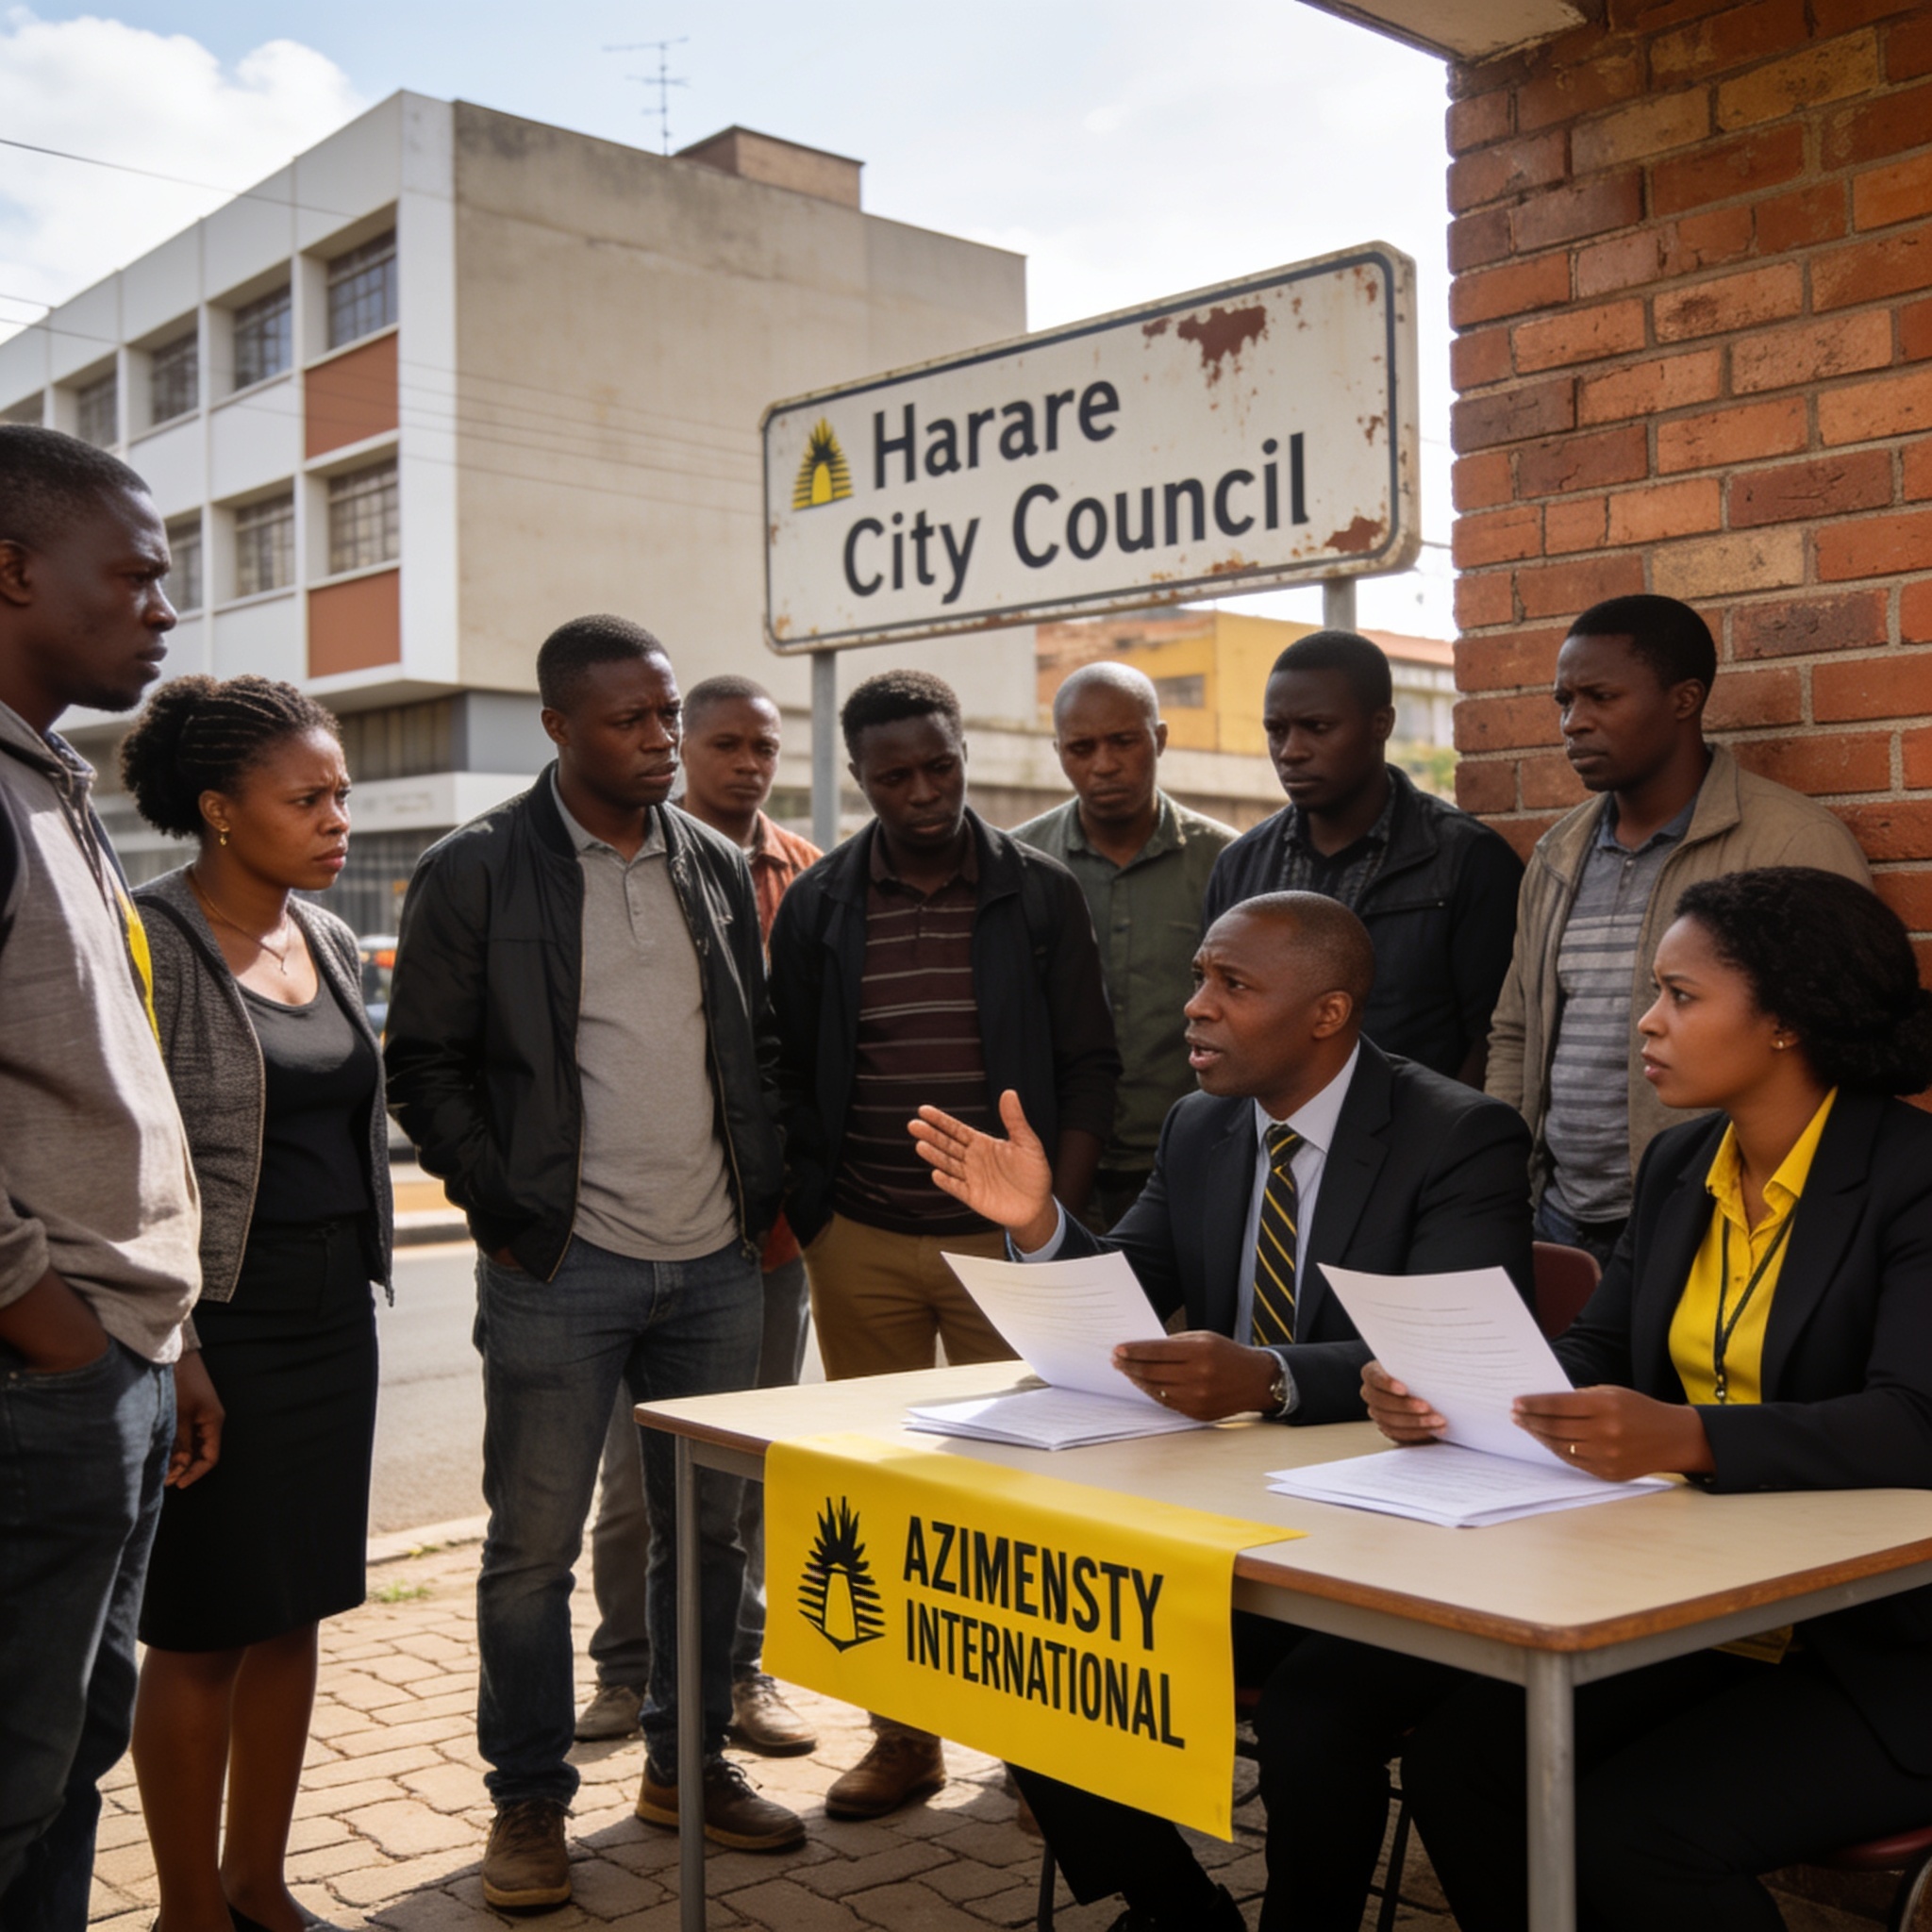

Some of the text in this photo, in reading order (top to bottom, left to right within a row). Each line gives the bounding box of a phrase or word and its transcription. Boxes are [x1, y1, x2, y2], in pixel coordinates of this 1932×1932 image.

[874, 380, 1120, 489] Harare
[843, 432, 1309, 604] City Council
[904, 1516, 1163, 1651] AZIMENSTY
[907, 1600, 1185, 1749] INTERNATIONAL
